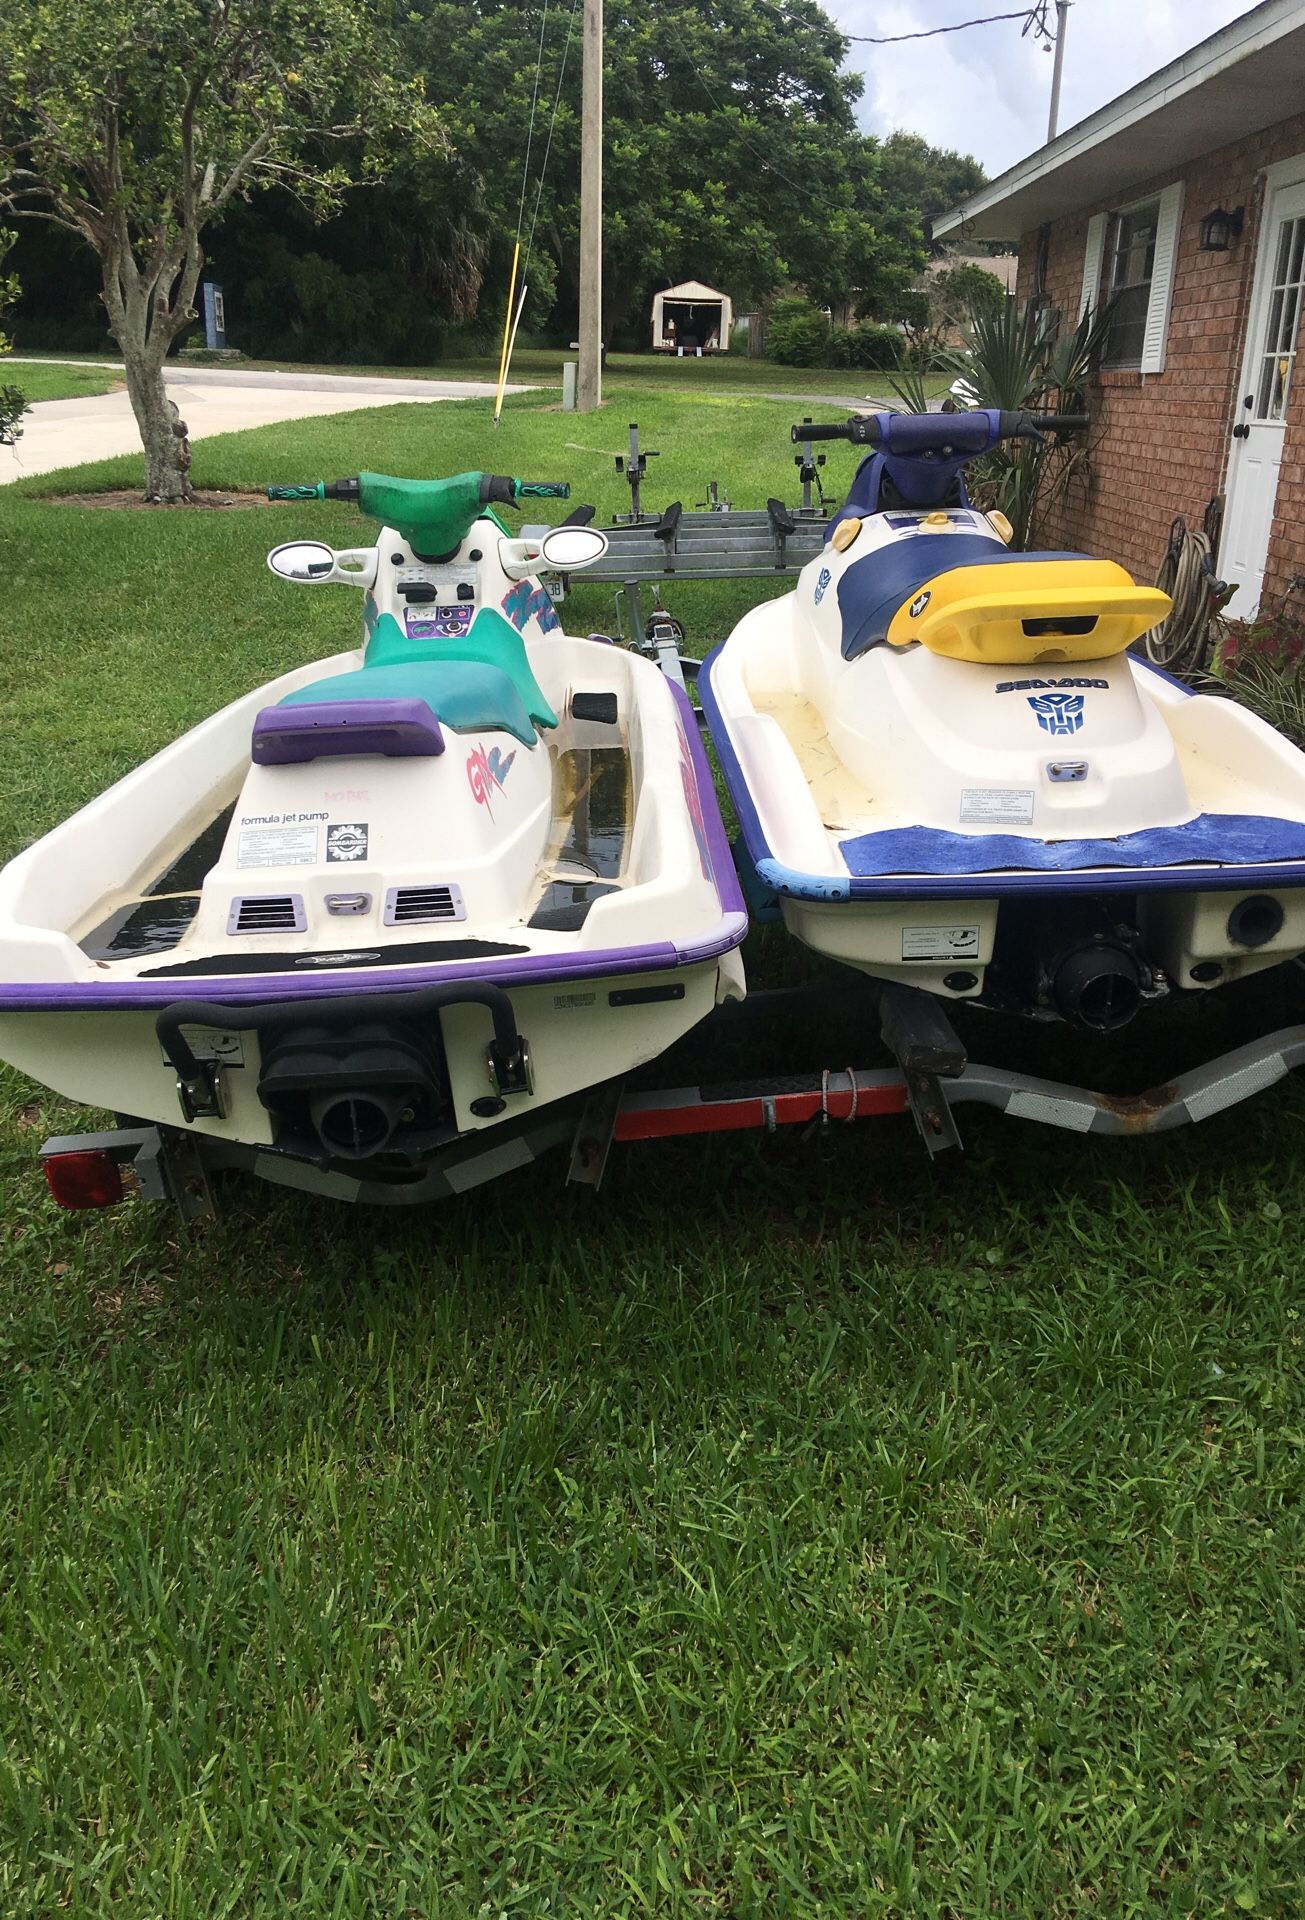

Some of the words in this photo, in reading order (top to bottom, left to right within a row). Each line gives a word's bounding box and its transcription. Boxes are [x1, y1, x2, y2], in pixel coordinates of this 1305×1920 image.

[241, 814, 280, 826] formula
[282, 813, 296, 824] jet
[298, 812, 330, 823] pump
